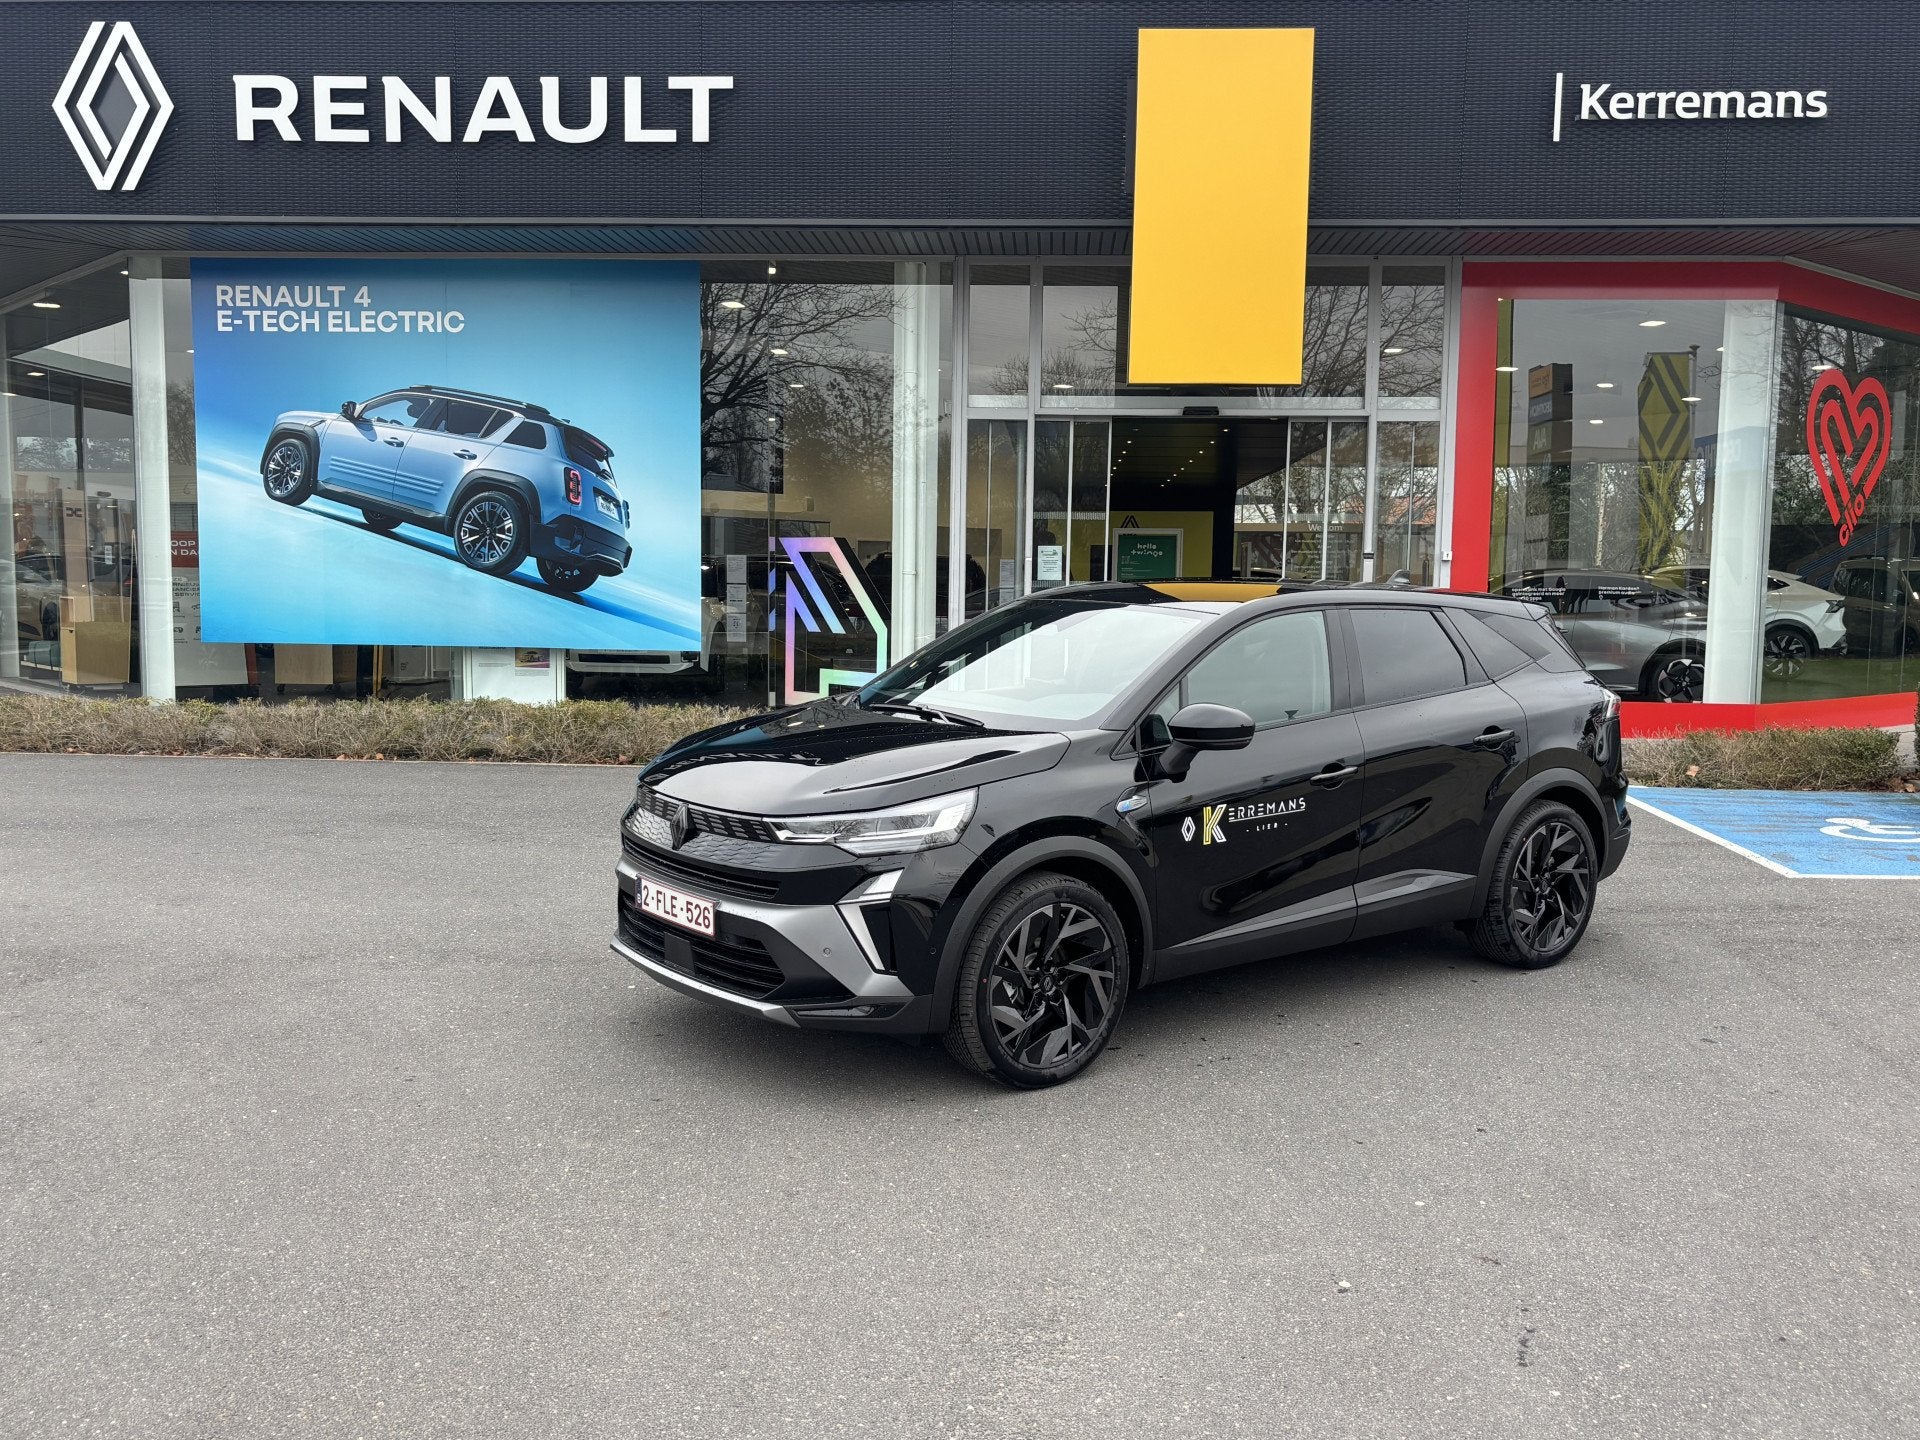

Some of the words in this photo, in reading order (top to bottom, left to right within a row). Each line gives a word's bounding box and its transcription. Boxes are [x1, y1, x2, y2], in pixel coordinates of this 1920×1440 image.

[233, 75, 734, 144] RENAULT
[1580, 83, 1828, 120] Kerremans
[216, 285, 346, 307] RENAULT
[353, 285, 371, 307] 4
[217, 310, 320, 332] E-TECH
[327, 310, 465, 333] ELECTRIC
[1308, 524, 1343, 532] Weom
[1839, 494, 1865, 547] clio
[1203, 797, 1306, 846] KERREMANS
[643, 884, 711, 930] 2-FLE-526
